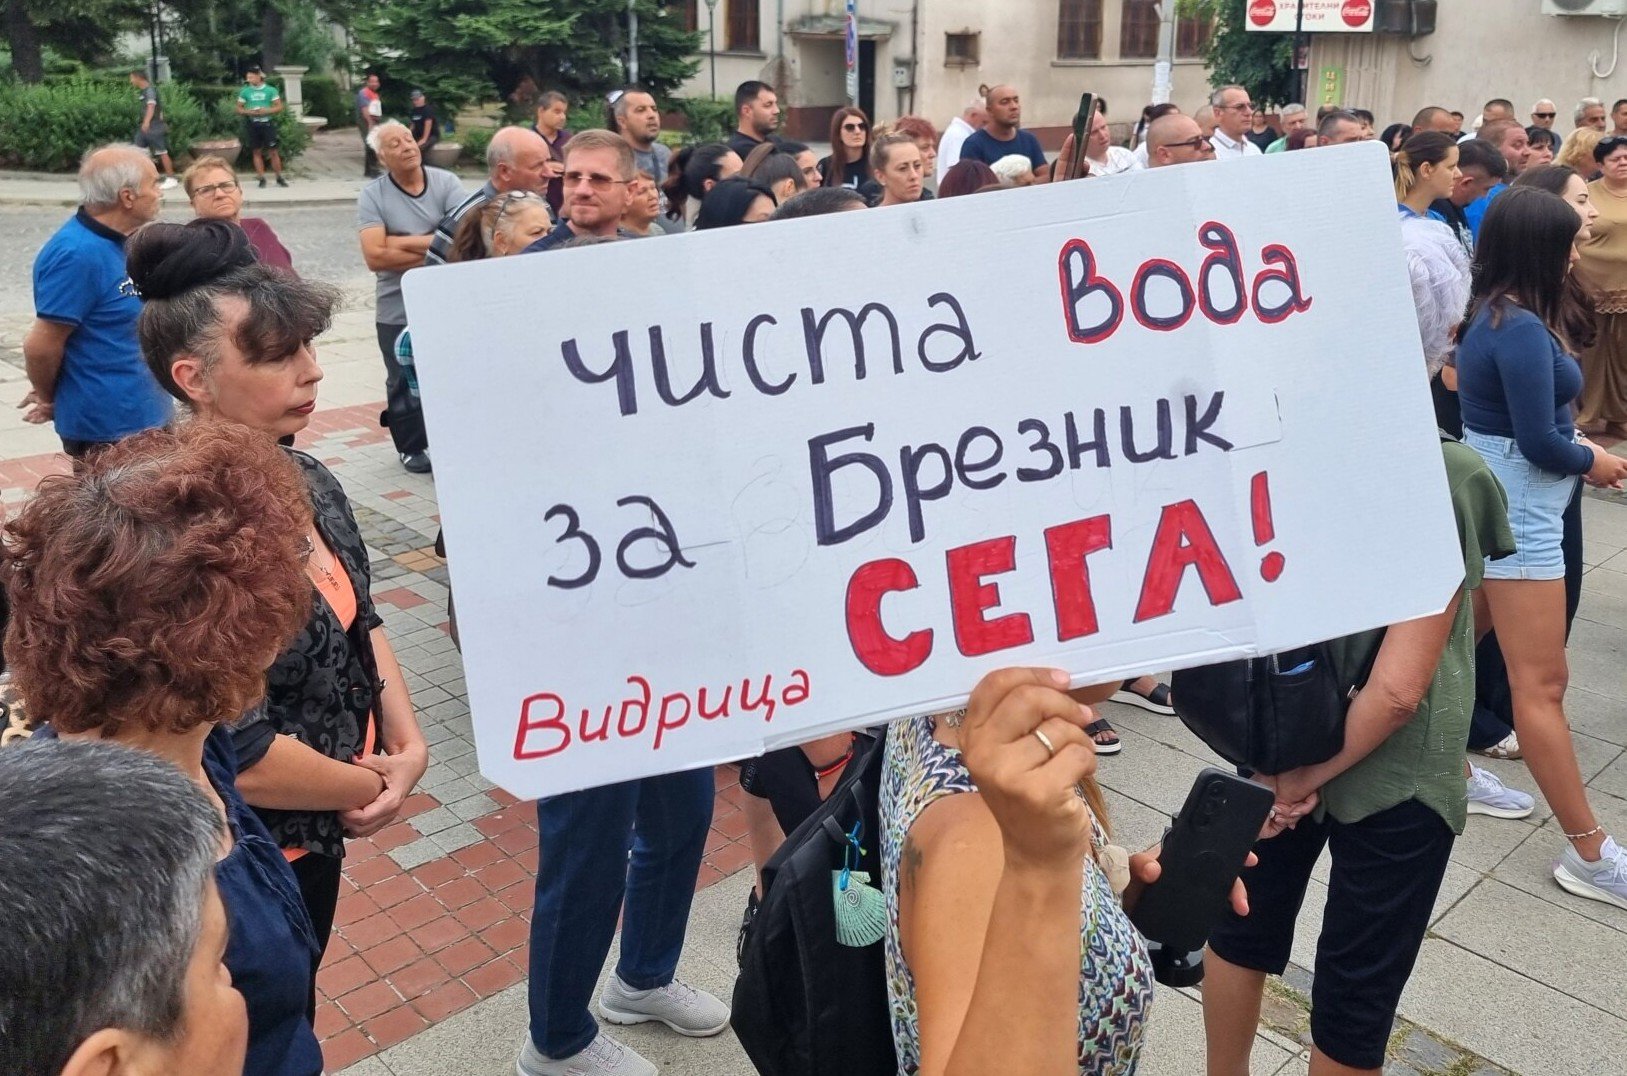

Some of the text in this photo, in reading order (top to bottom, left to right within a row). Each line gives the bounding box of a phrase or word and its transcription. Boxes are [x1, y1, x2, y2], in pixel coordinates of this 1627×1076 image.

[1279, 2, 1340, 10] ХРАИТЕЛНИ
[808, 390, 1234, 546] Брезник
[845, 471, 1286, 677] СЕГА!
[513, 669, 811, 762] Видрица
